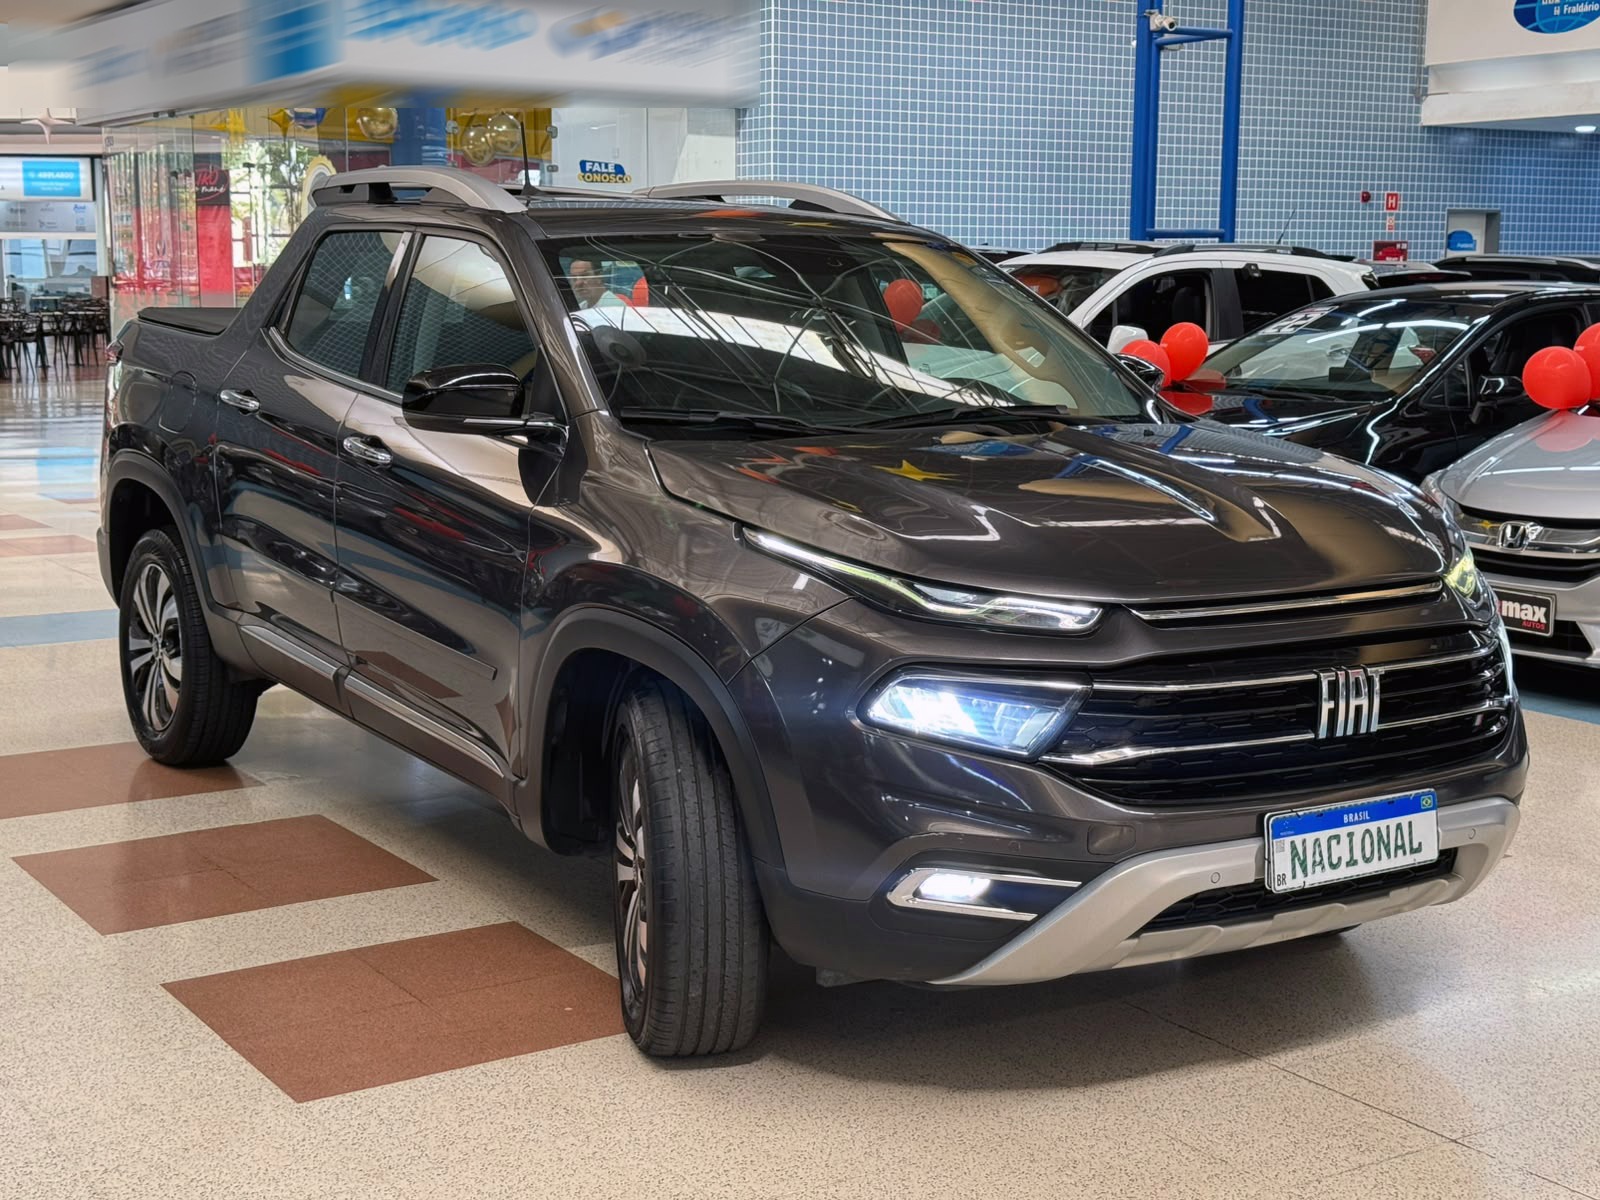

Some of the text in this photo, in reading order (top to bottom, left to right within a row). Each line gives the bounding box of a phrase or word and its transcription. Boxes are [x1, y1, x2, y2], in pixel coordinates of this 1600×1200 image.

[1563, 2, 1600, 14] Fraldário
[585, 162, 615, 172] FALE
[577, 172, 632, 183] CONOSCO
[1522, 621, 1545, 629] AUTOS
[1319, 667, 1385, 739] FIAT
[1343, 810, 1370, 824] BRASIL
[1290, 820, 1422, 880] NACIONAL
[1276, 873, 1287, 887] BR
